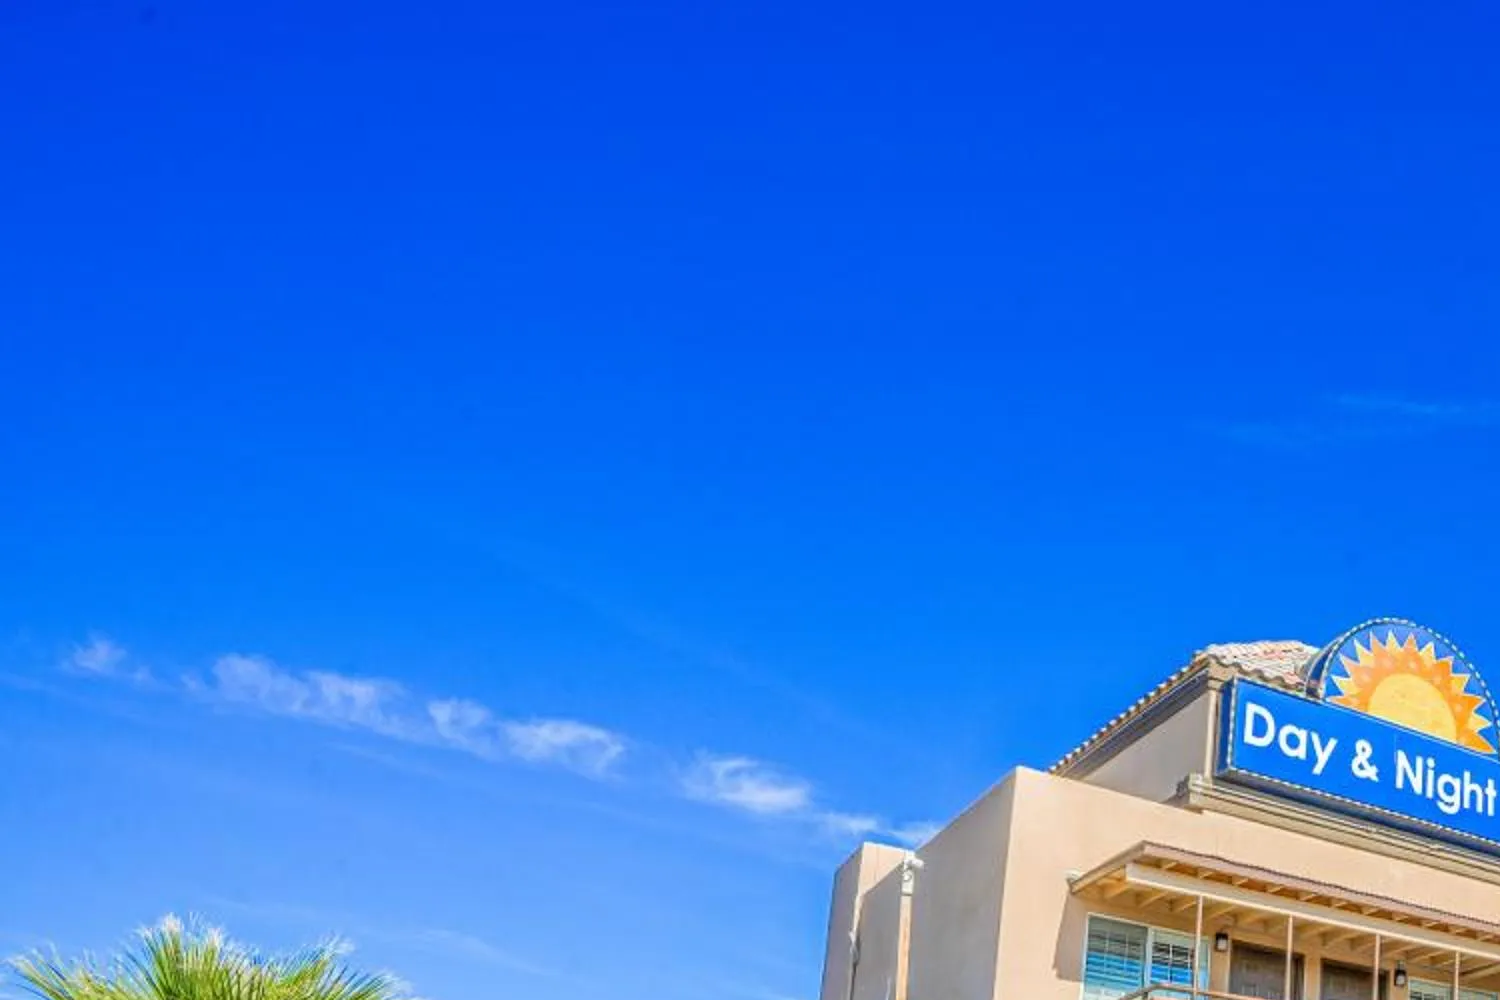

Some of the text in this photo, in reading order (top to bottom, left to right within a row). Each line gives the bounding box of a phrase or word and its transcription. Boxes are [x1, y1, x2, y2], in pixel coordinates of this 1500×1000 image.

[1243, 702, 1337, 775] Day
[1351, 739, 1379, 783] &
[1395, 749, 1497, 815] Night
